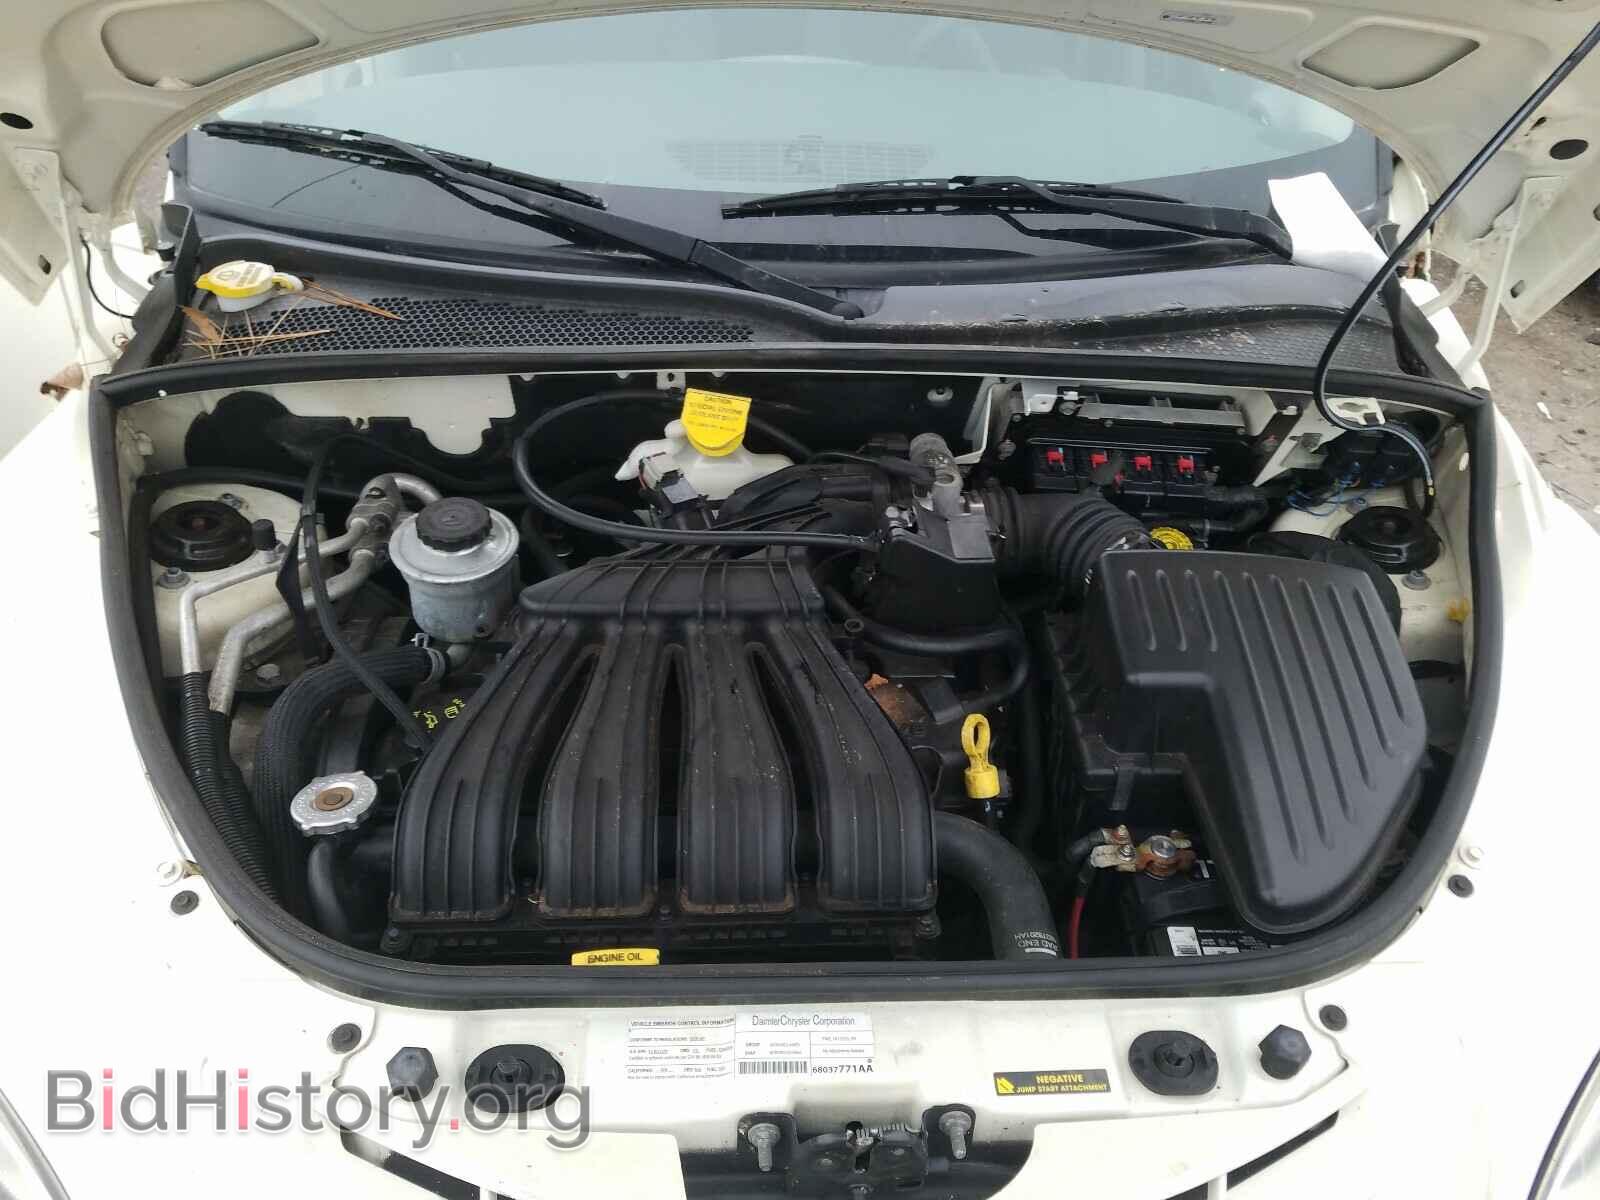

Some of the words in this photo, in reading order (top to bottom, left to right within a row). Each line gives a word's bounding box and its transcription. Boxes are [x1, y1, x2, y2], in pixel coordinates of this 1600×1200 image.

[587, 952, 625, 964] ENGINE
[627, 952, 644, 961] OIL
[702, 1018, 735, 1026] INFORMATION
[752, 1014, 811, 1028] DaimlerChrysler
[813, 1014, 855, 1027] Corporation
[812, 1065, 874, 1074] 68037771AA
[1035, 1073, 1084, 1084] NEGATIVE
[1016, 1086, 1036, 1094] JUMP
[1038, 1085, 1058, 1093] START
[1060, 1083, 1107, 1092] ATTACHMENT
